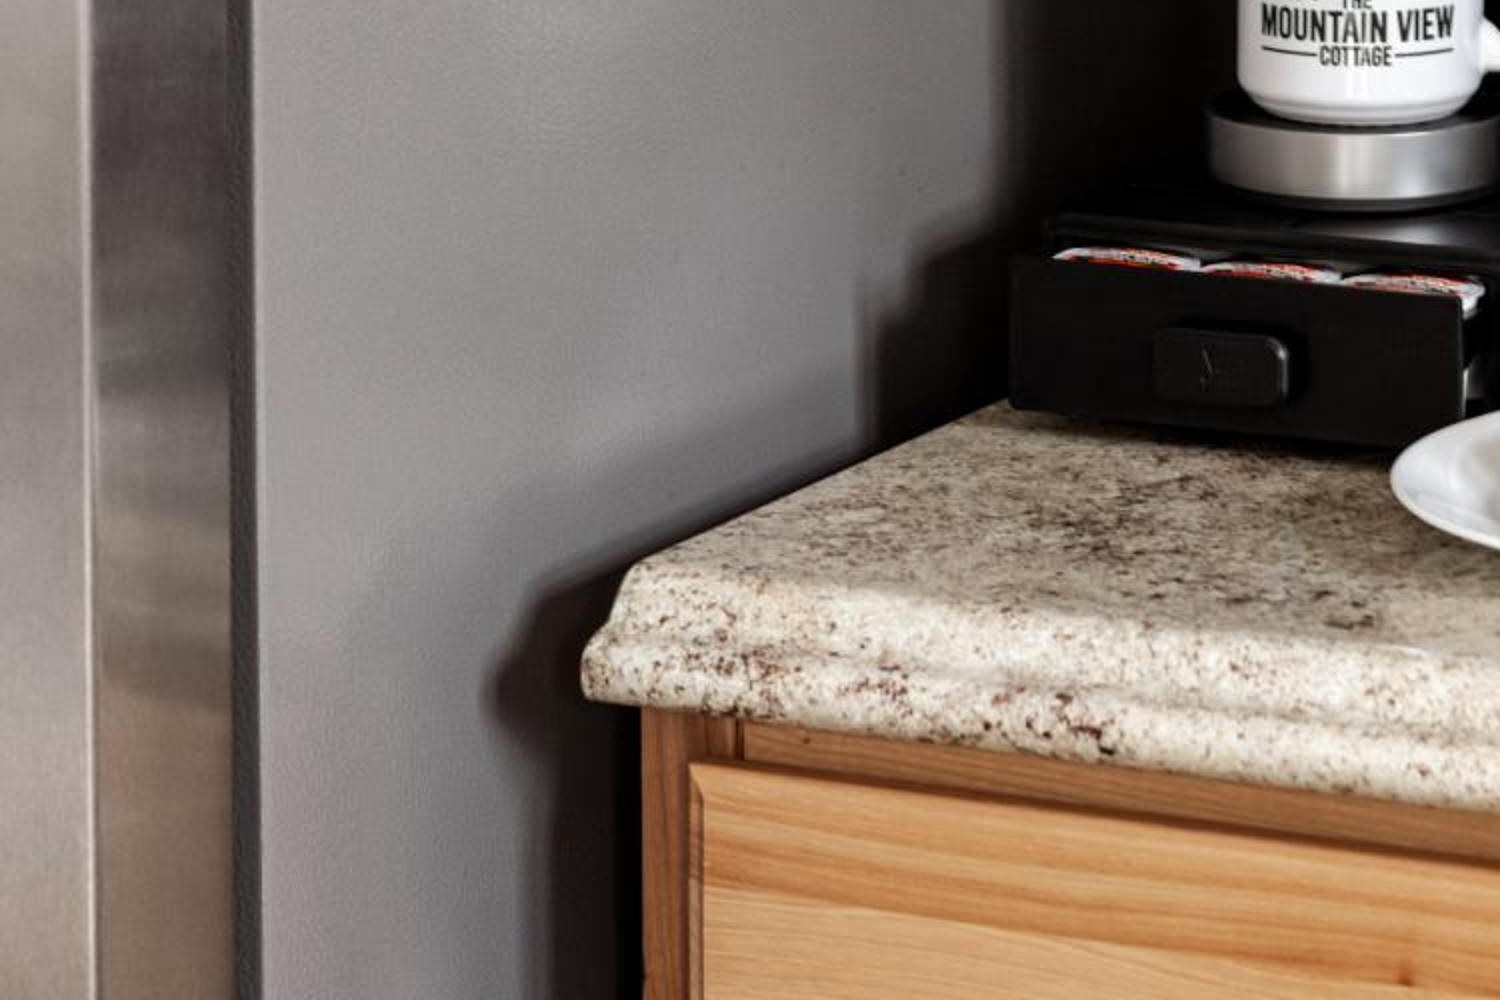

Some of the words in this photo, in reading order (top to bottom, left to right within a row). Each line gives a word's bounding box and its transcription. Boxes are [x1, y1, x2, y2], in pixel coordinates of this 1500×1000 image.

[1261, 2, 1388, 44] MOUNTAIN
[1396, 4, 1455, 43] VIEW
[1319, 45, 1393, 67] COTTAGE
